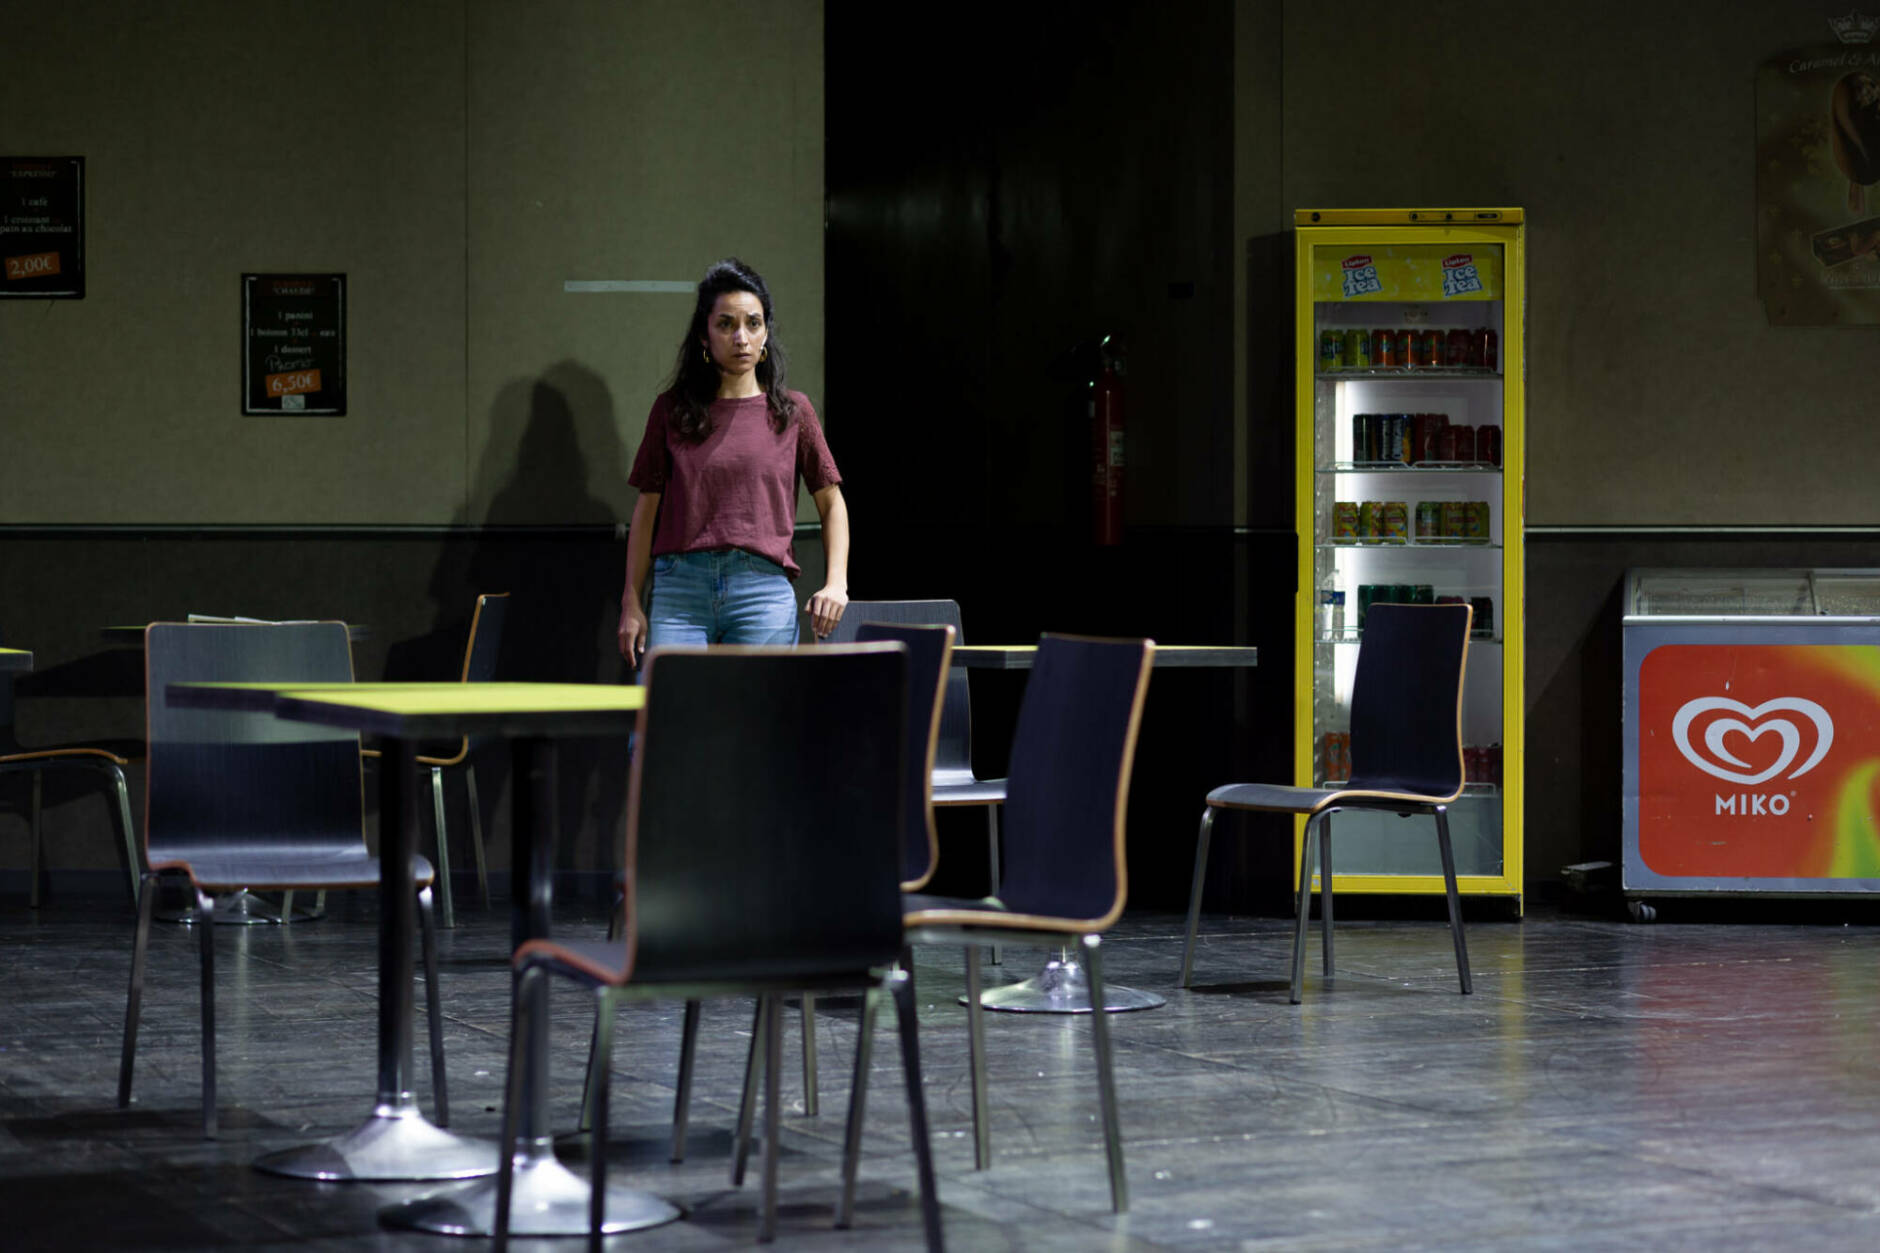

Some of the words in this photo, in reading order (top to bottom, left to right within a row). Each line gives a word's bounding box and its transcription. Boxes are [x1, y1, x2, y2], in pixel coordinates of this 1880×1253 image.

[1789, 52, 1846, 74] Caramel
[35, 224, 72, 233] chocolat
[1345, 266, 1376, 280] Ice
[1445, 265, 1476, 280] Ice
[1343, 278, 1379, 297] Tea
[1444, 277, 1480, 297] Tea
[272, 373, 315, 393] 6,50€
[1715, 794, 1790, 816] MIKO
